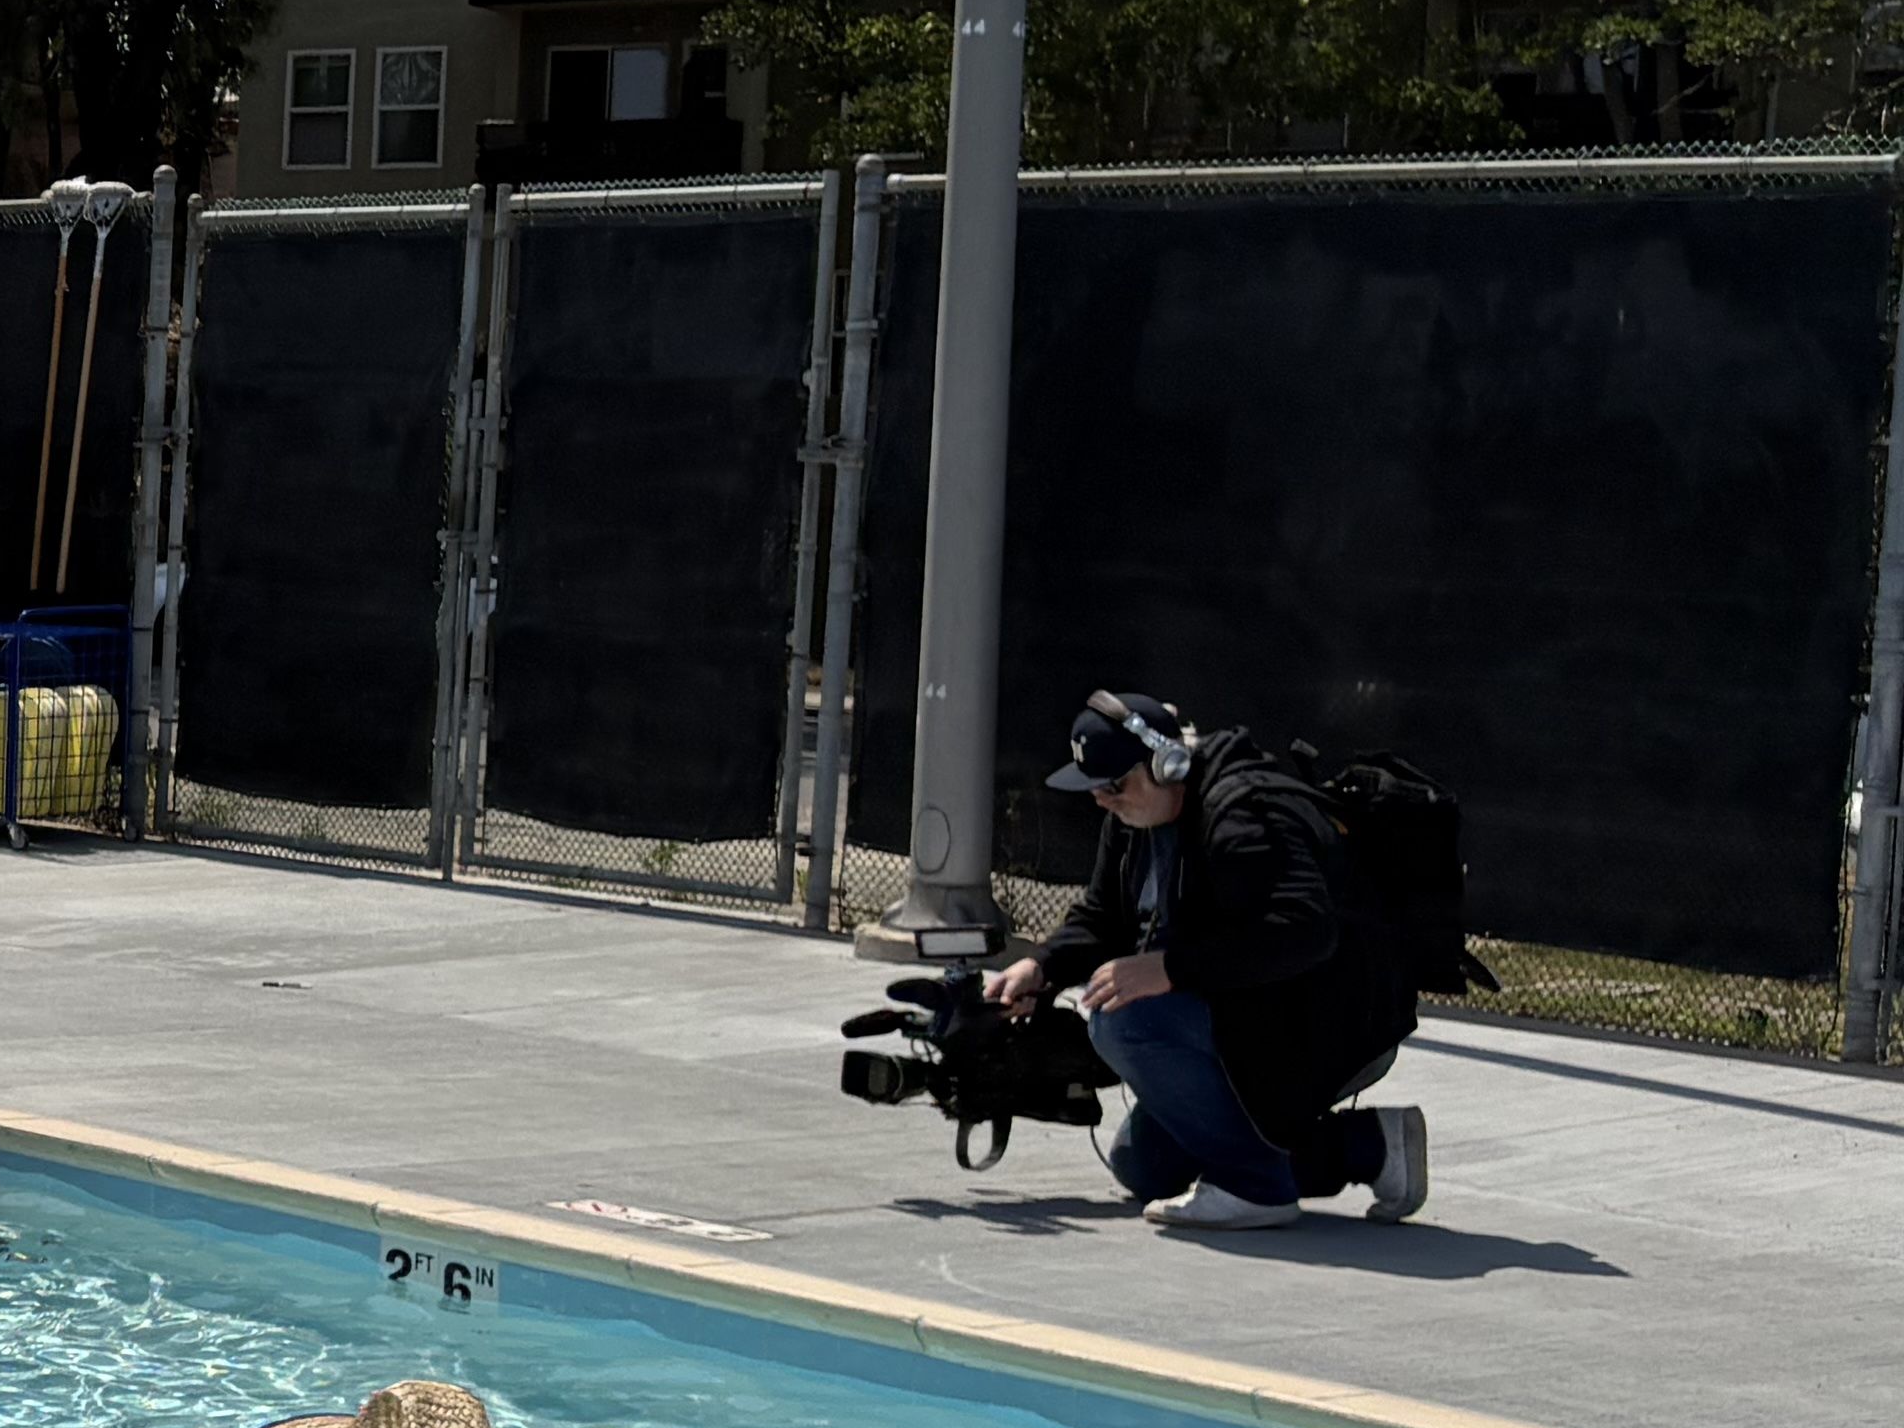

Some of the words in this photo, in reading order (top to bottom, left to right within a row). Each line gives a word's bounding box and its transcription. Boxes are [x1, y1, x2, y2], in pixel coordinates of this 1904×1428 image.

[386, 1249, 413, 1282] 2
[415, 1252, 436, 1273] FT
[443, 1262, 472, 1301] 6
[475, 1268, 494, 1288] IN
